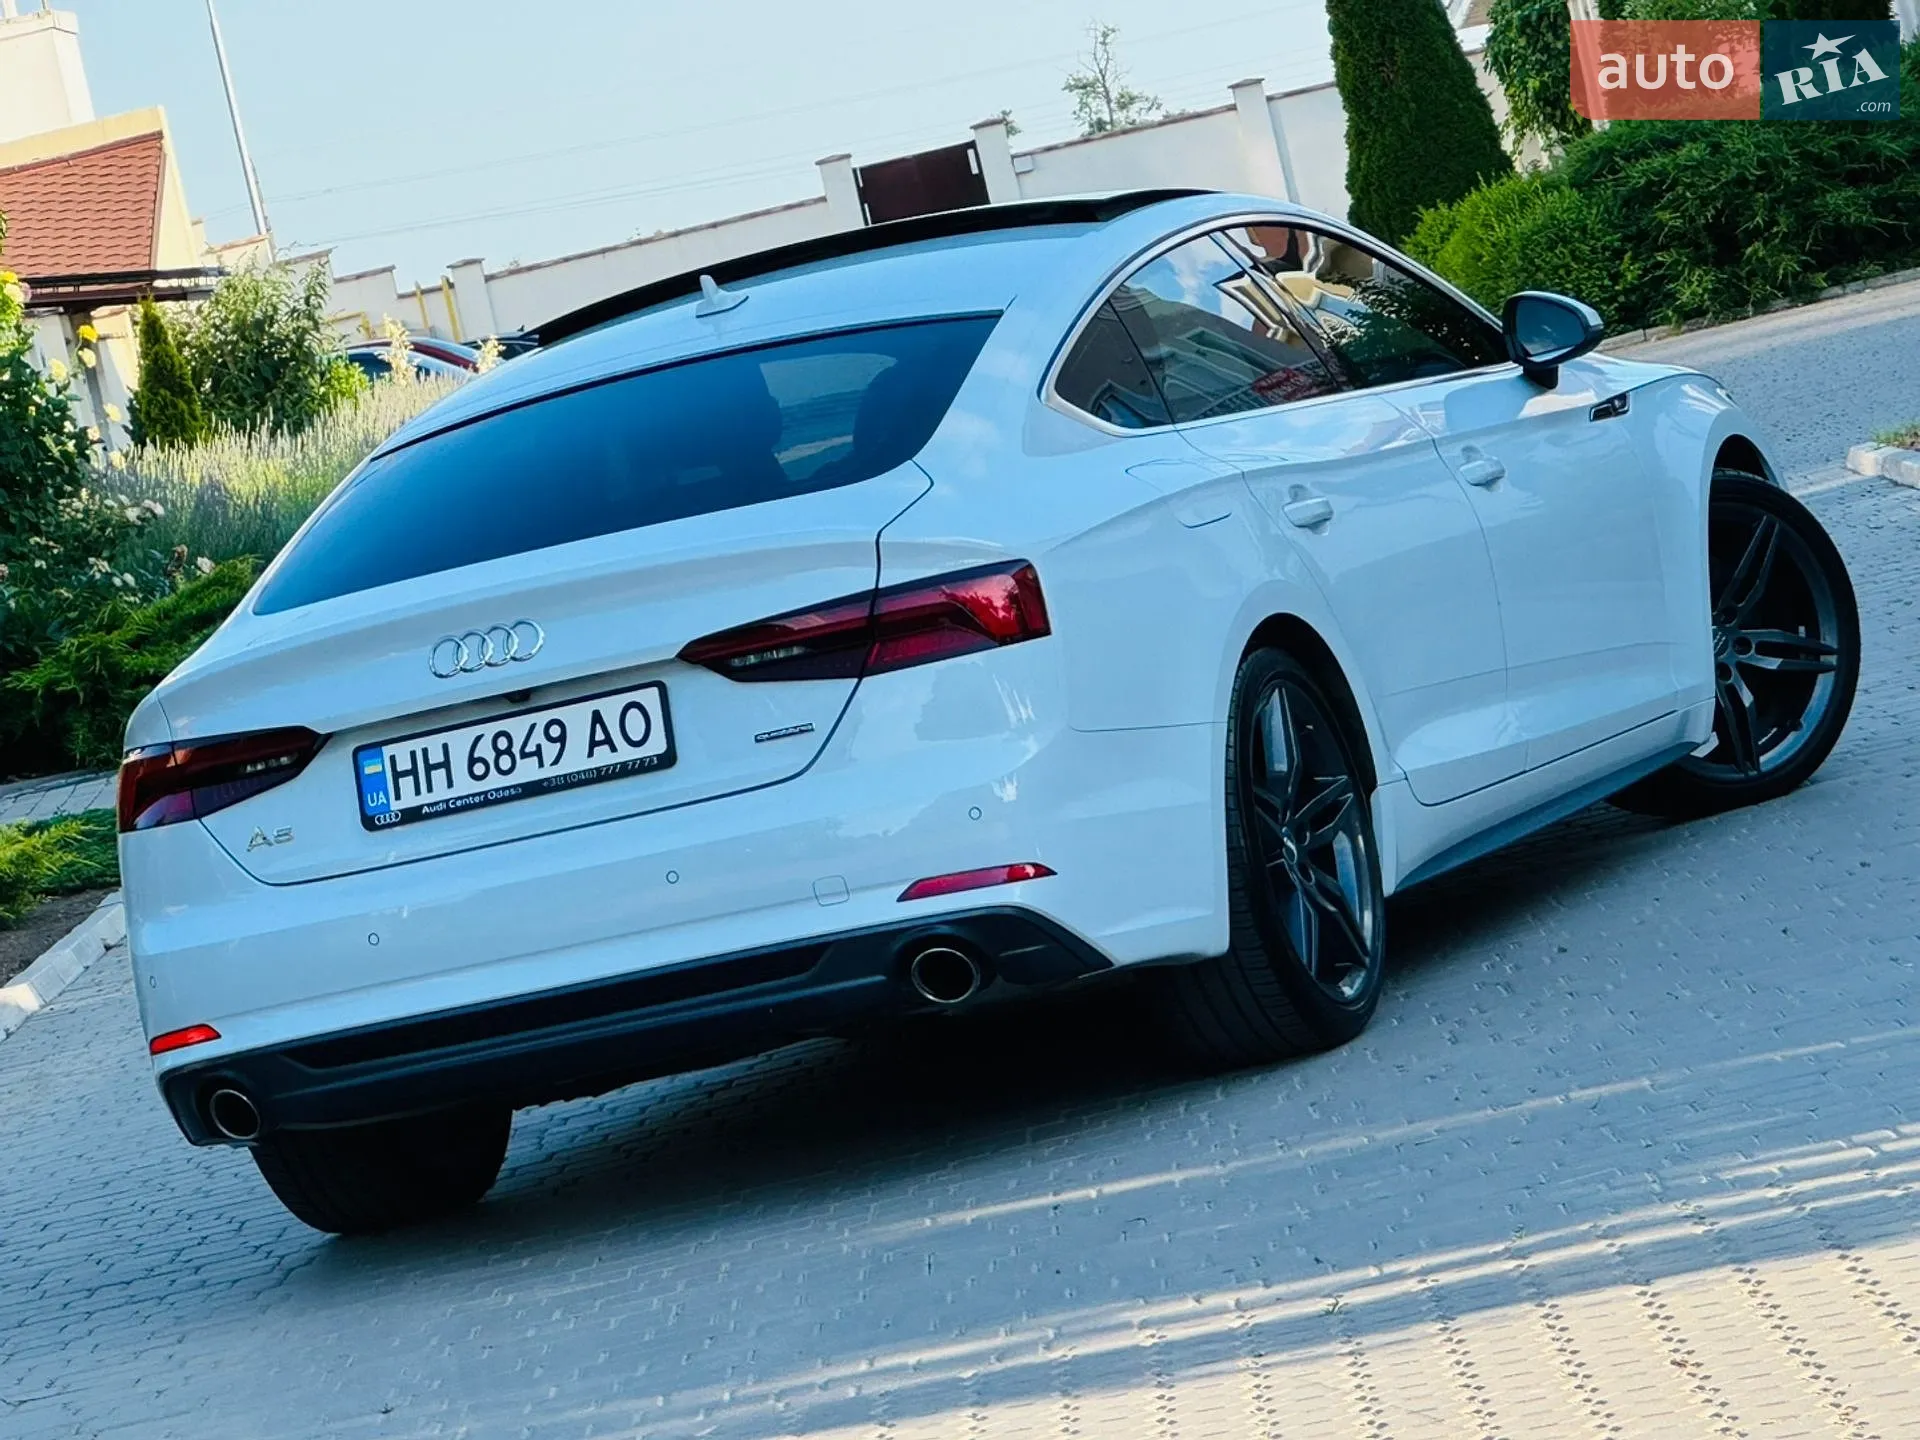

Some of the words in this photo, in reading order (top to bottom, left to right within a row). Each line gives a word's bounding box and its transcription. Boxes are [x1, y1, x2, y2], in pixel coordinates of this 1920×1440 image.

[389, 742, 454, 801] HH
[466, 718, 567, 782] 6849
[586, 700, 652, 759] AO
[367, 790, 387, 807] UA
[421, 803, 447, 814] Audi
[448, 793, 486, 808] Center
[487, 786, 522, 800] Odesa
[246, 826, 294, 852] A5
